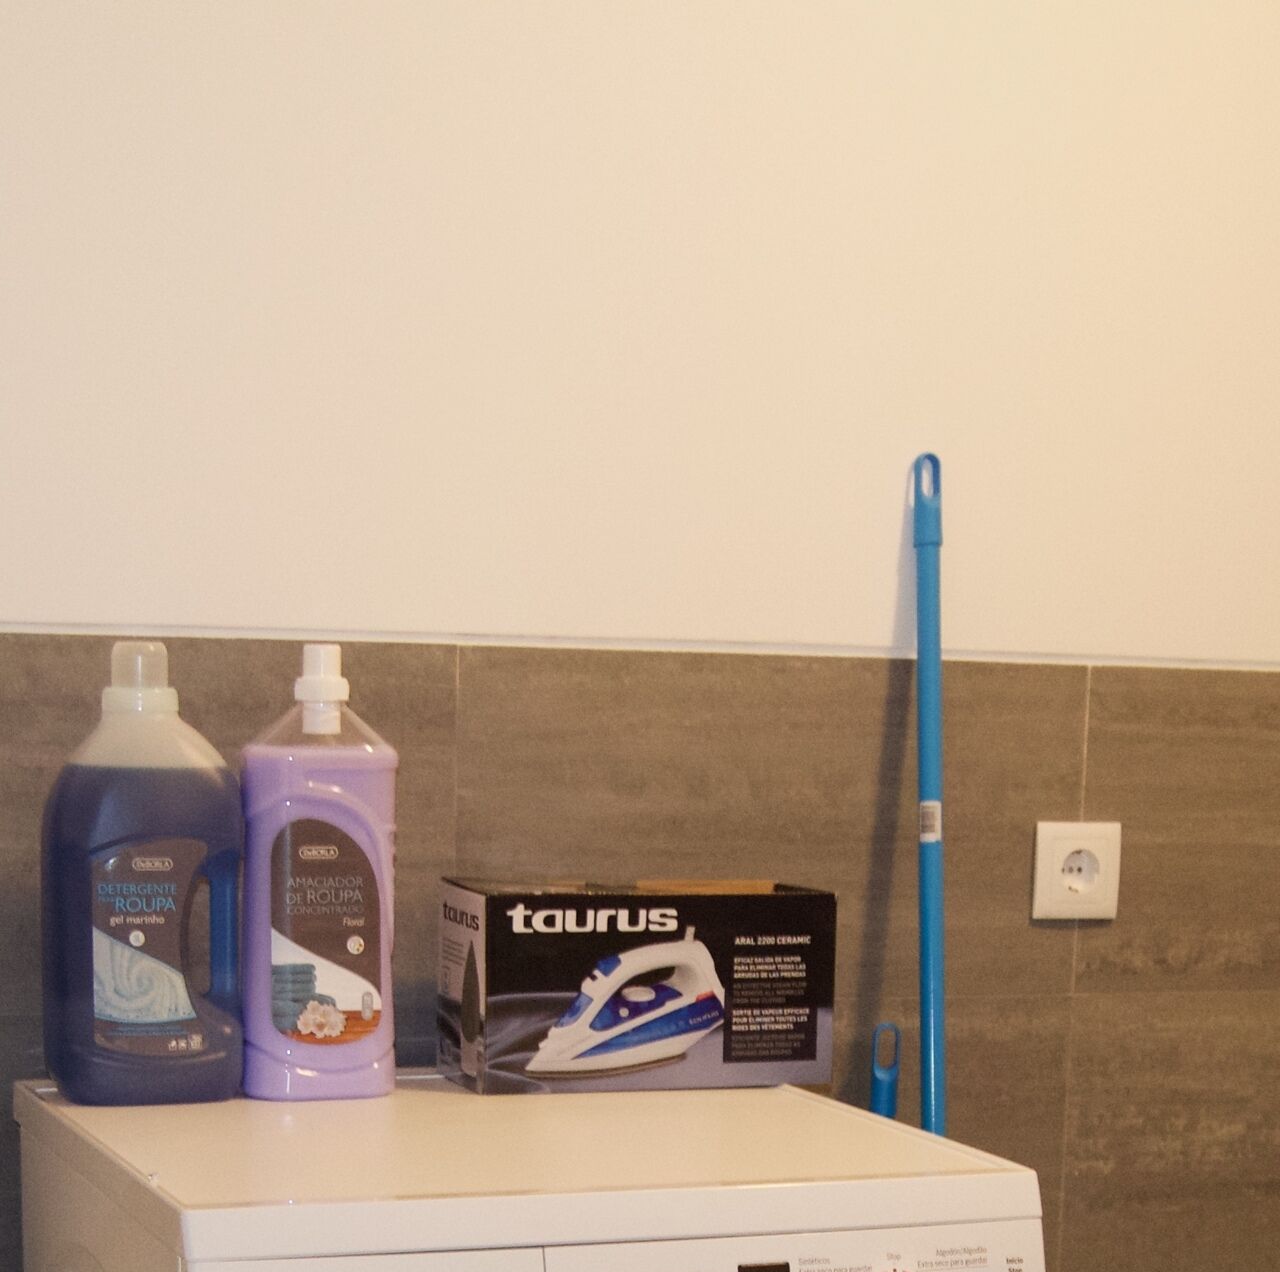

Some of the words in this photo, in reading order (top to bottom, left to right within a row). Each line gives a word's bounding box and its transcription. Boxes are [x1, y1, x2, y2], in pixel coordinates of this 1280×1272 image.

[286, 875, 364, 888] AMACIADOR
[97, 883, 177, 895] DETERGENTE
[307, 889, 364, 904] ROUPA
[115, 897, 177, 912] ROUPA
[109, 915, 124, 928] gel
[126, 914, 166, 925] marinho
[443, 900, 480, 932] taurus
[506, 902, 678, 934] taurus
[734, 935, 756, 945] ARAL
[776, 935, 812, 945] CERAMIC
[886, 1251, 901, 1262] Stop
